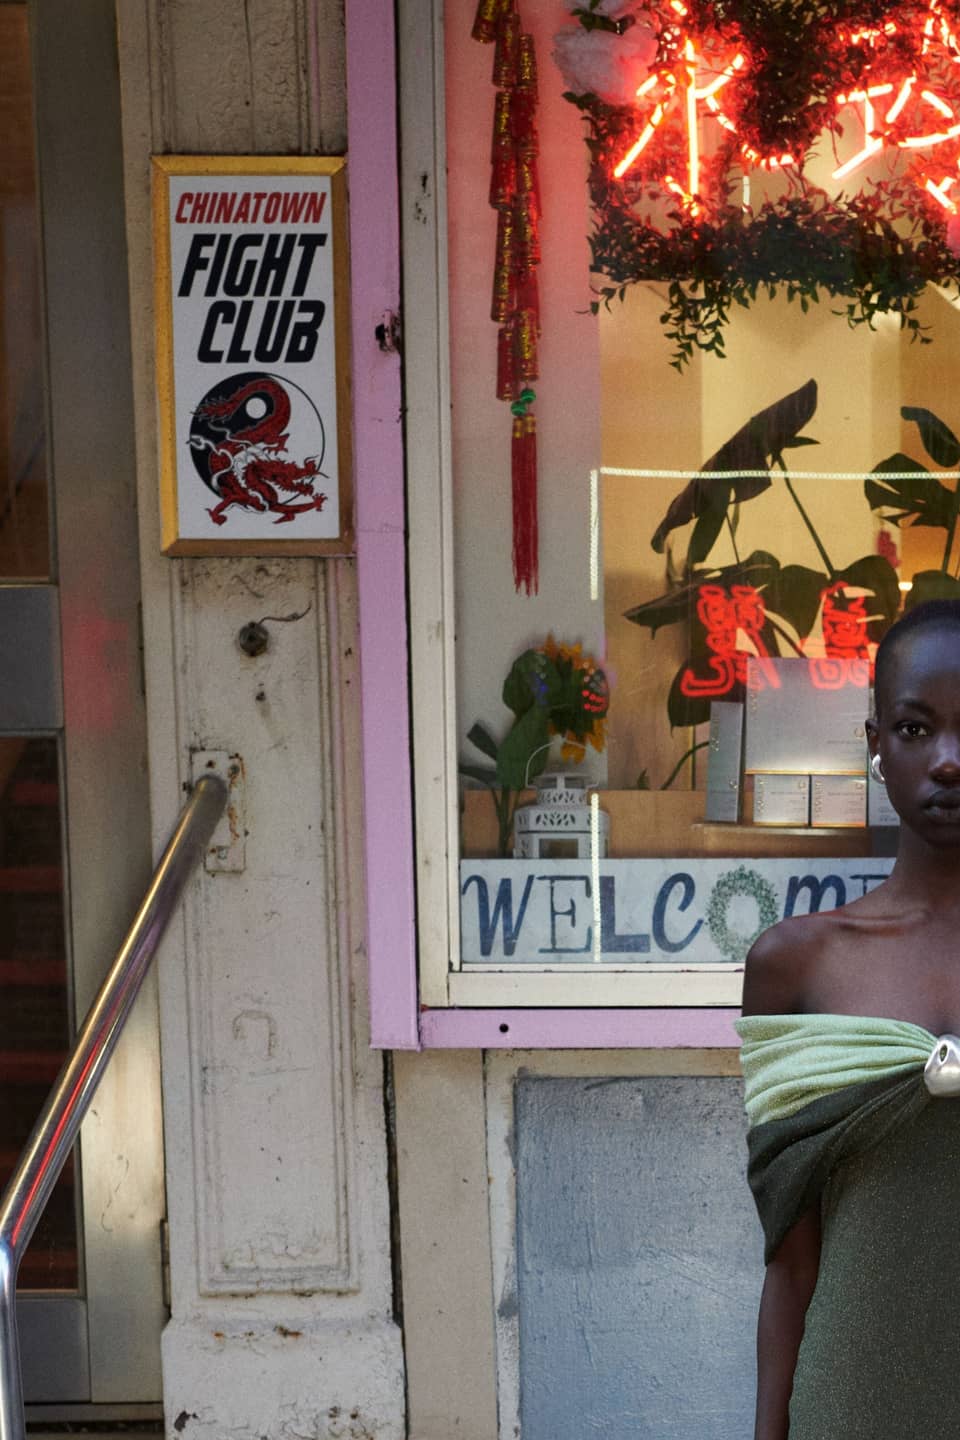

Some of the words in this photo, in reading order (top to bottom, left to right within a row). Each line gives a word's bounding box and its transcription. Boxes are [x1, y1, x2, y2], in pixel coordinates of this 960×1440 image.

[175, 191, 327, 225] CHINATOWN
[177, 233, 328, 298] FIGHT
[197, 300, 326, 364] CLUB
